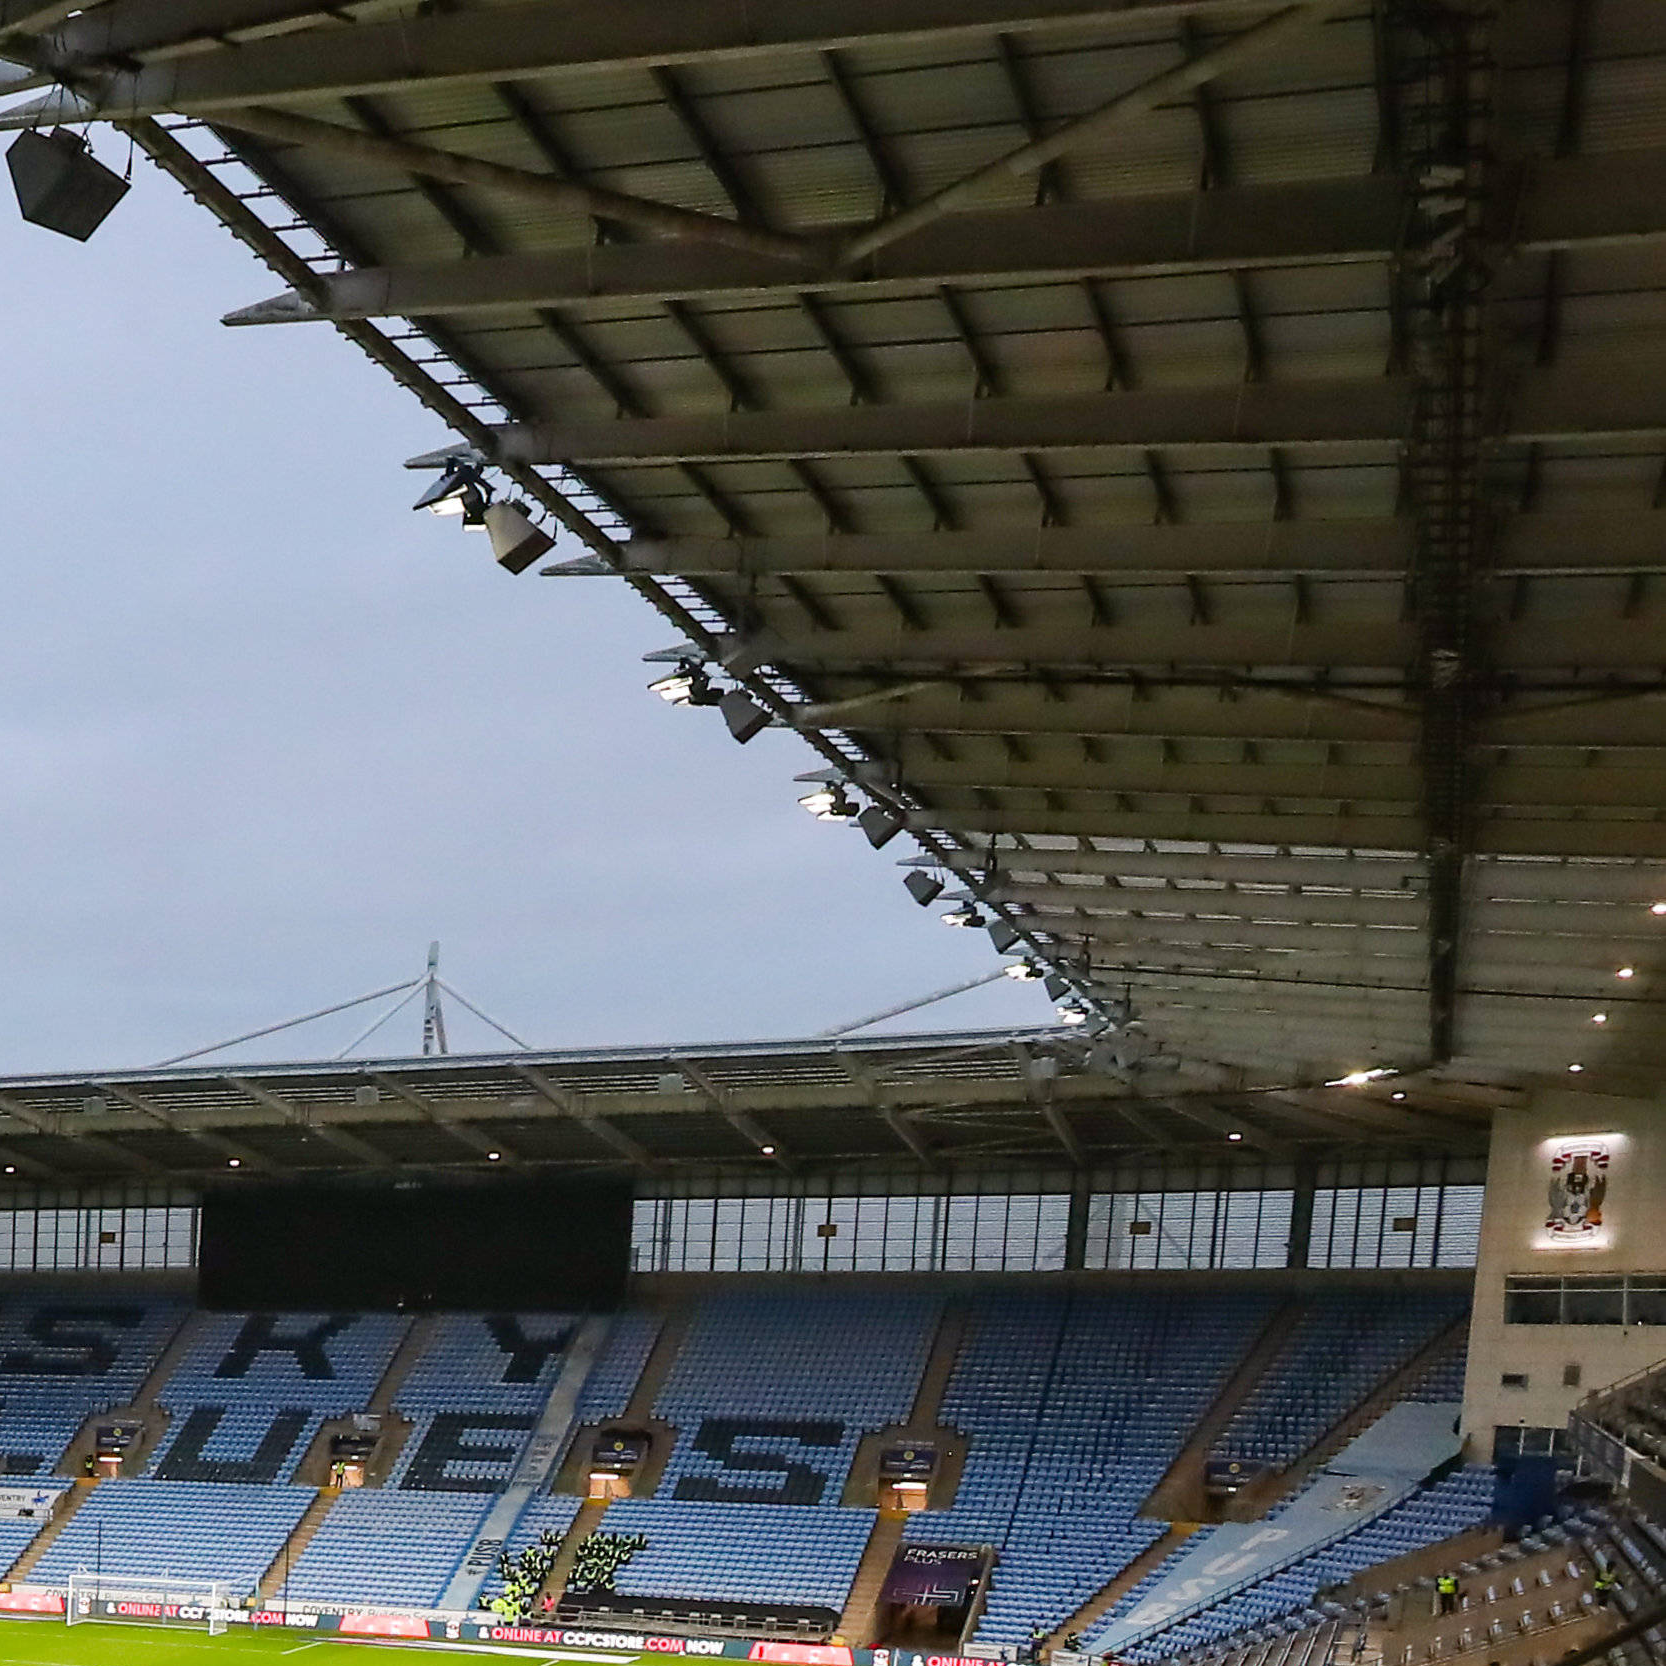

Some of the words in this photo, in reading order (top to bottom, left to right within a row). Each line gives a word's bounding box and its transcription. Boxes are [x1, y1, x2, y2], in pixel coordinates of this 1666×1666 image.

[903, 1555, 942, 1566] PLUS
[906, 1548, 979, 1560] FRASERS
[106, 1602, 117, 1614] &
[118, 1602, 161, 1617] ONLINE
[285, 1612, 318, 1627] NOW
[478, 1626, 490, 1639] &
[491, 1627, 542, 1643] ONLINE
[543, 1631, 563, 1644] AT
[562, 1630, 685, 1653] CCFCSTORE.COM
[686, 1639, 725, 1655] NOW
